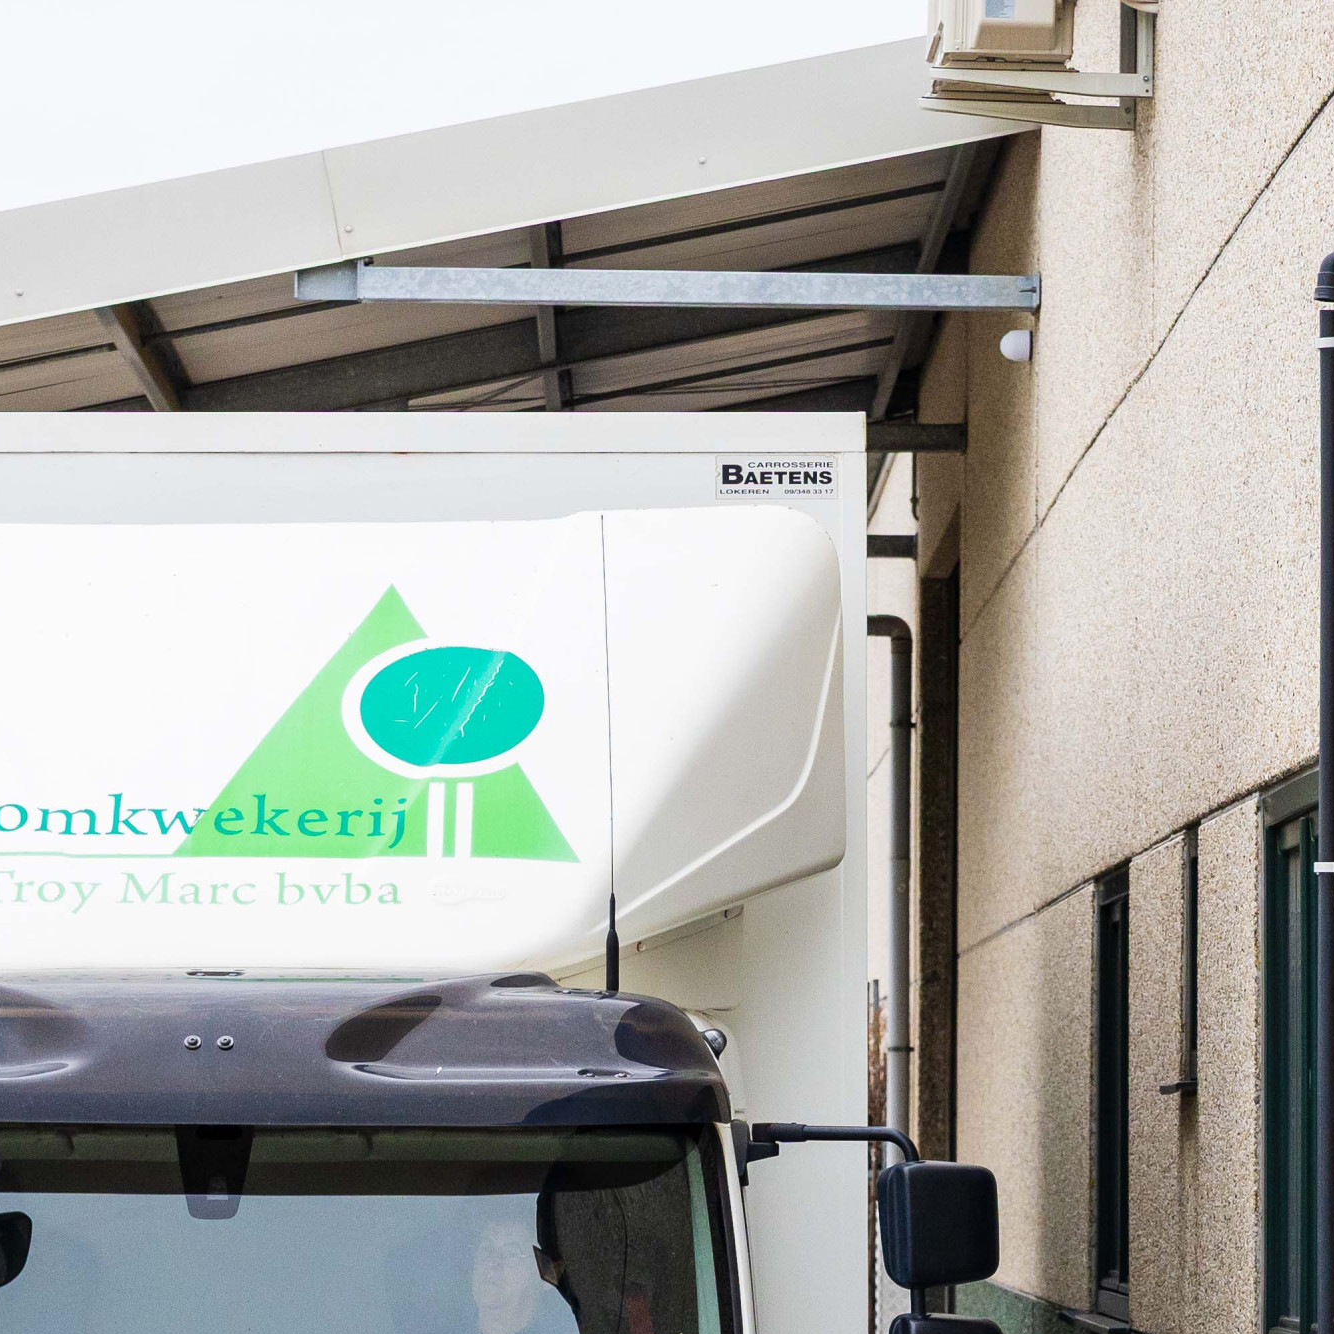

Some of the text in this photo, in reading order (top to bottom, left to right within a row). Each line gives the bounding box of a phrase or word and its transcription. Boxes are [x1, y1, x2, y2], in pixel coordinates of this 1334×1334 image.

[722, 464, 832, 484] BAETENS
[120, 871, 258, 906] Marc
[276, 873, 403, 906] bvba
